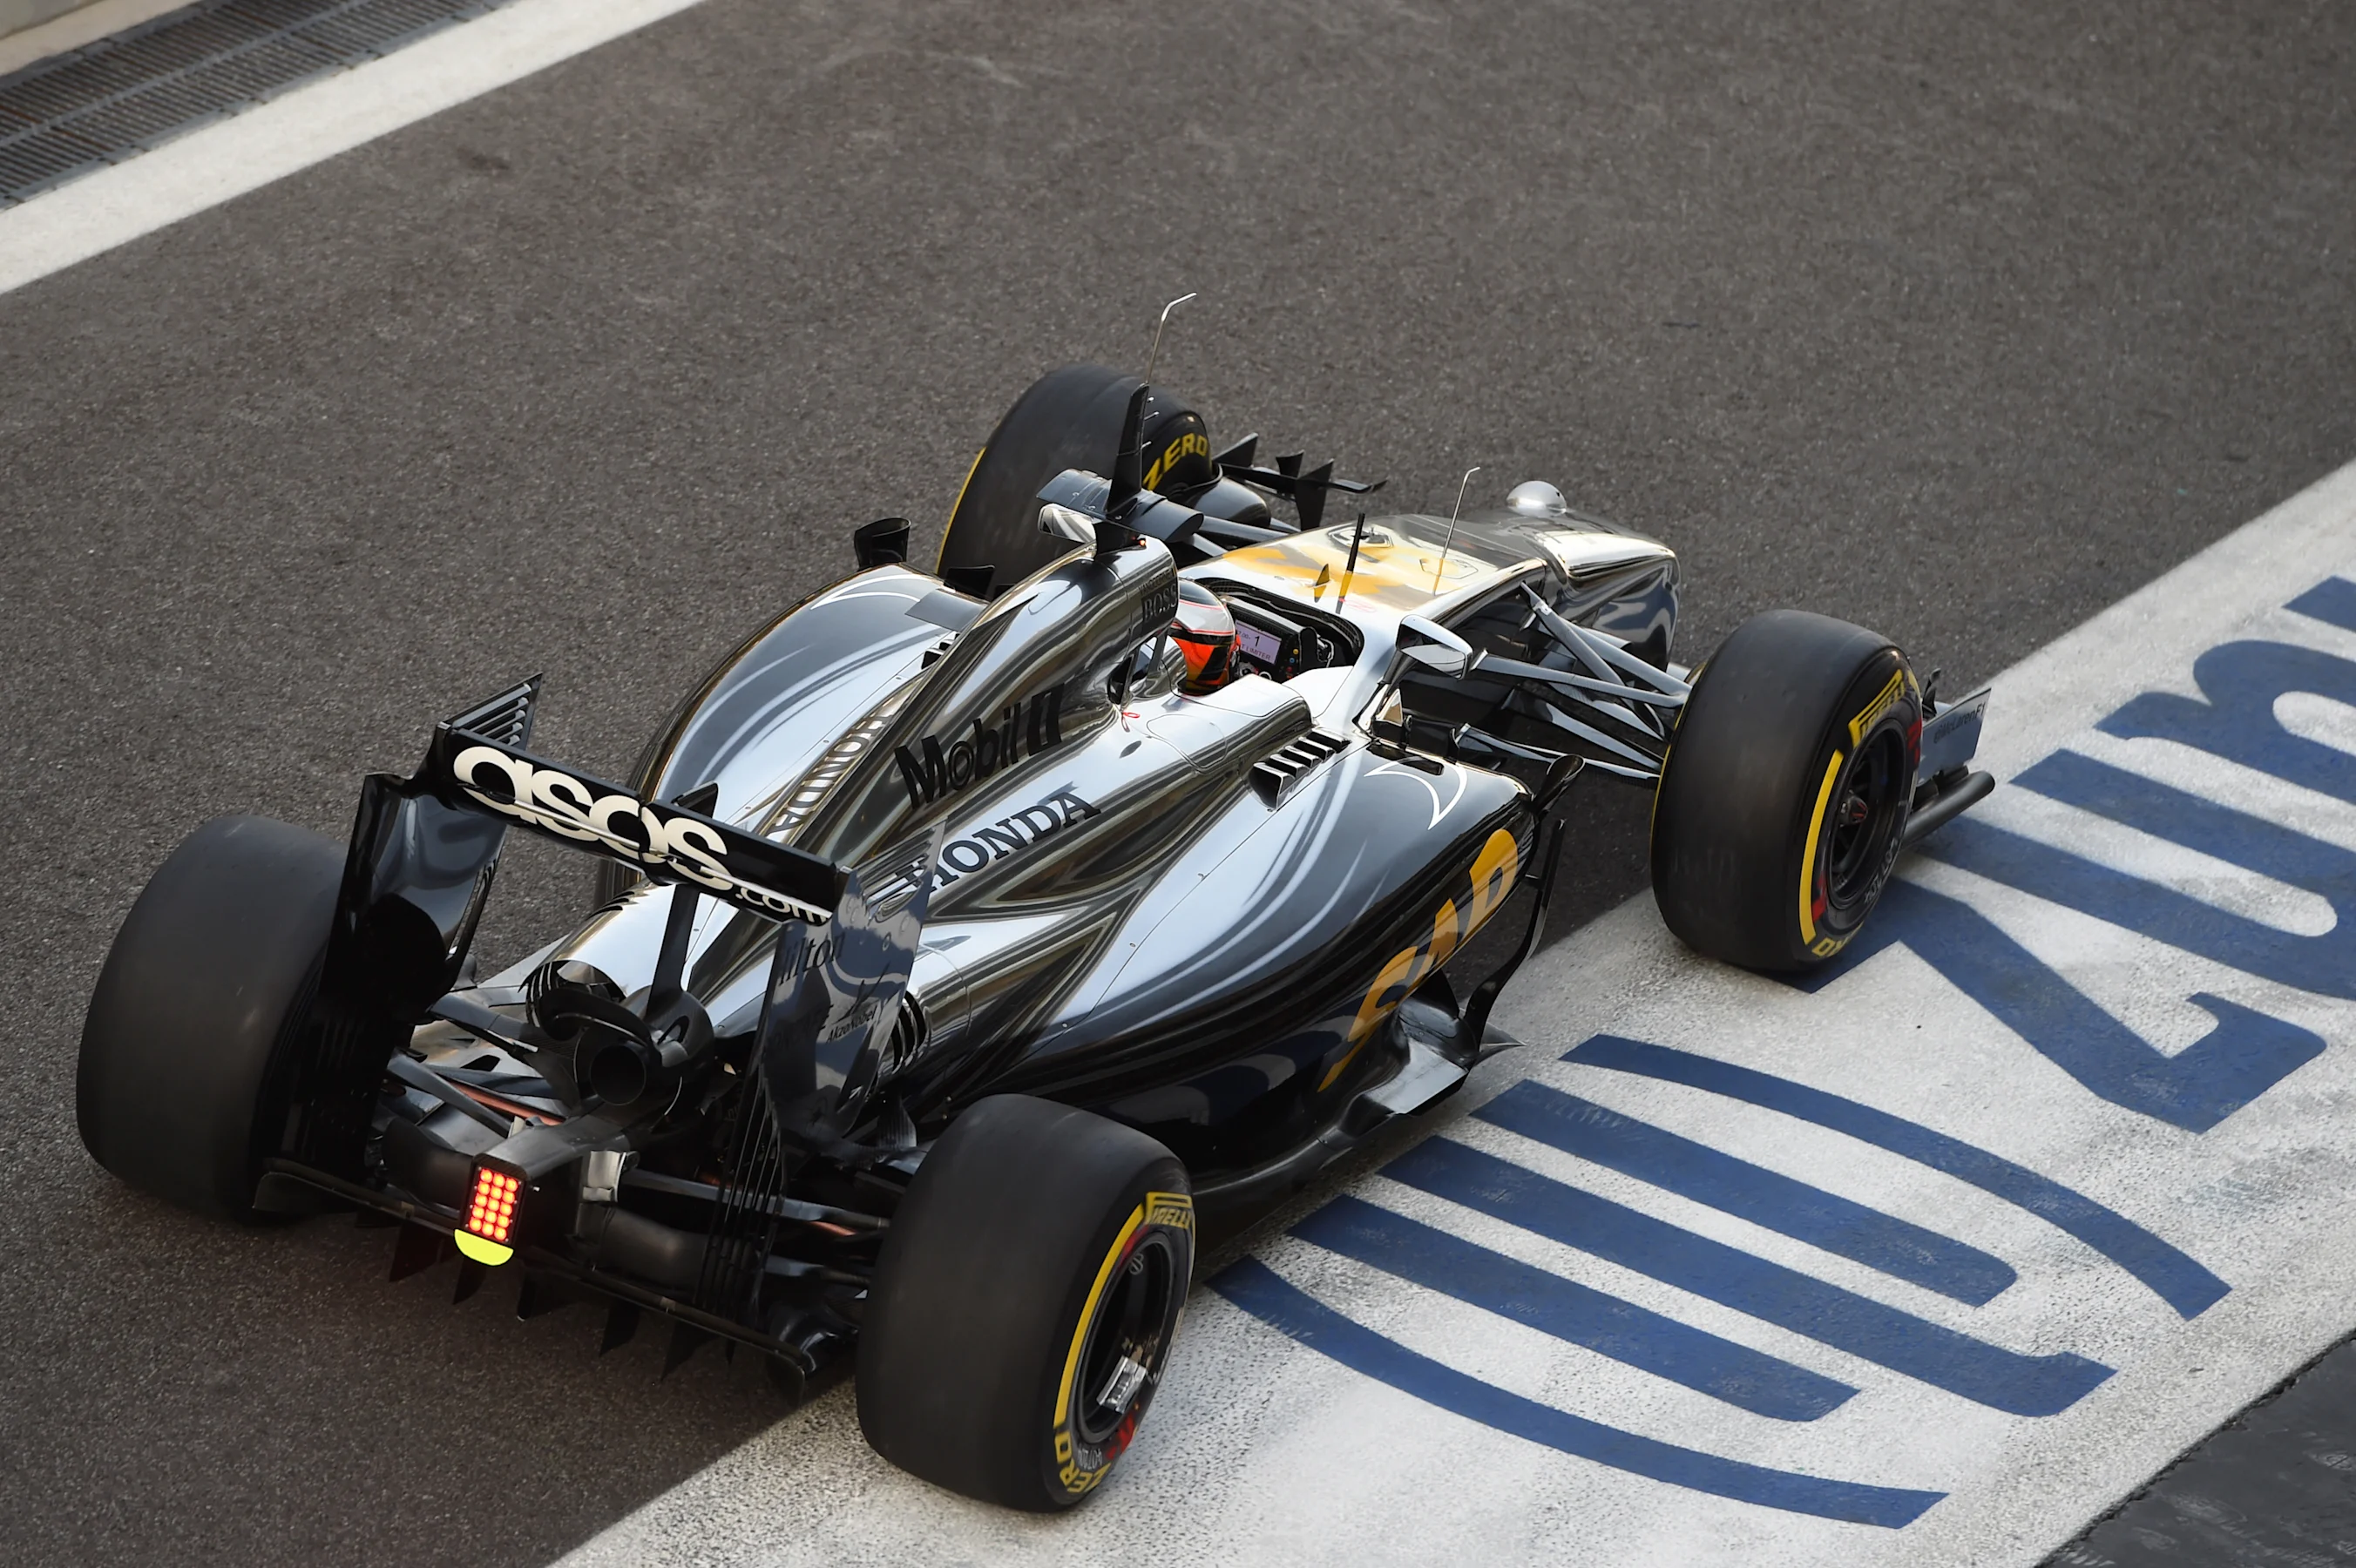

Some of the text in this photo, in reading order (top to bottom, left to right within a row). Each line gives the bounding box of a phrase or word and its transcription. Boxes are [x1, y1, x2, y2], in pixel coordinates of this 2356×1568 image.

[1141, 432, 1208, 492] ZERO
[1143, 582, 1178, 624] BOSS
[1246, 646, 1271, 661] LIMITER
[1254, 635, 1261, 647] 1
[1847, 668, 1906, 750] PIRELLI
[765, 714, 894, 837] HONDA
[894, 702, 1021, 809] Mobil
[826, 1004, 878, 1044] AkzoNobel
[1145, 1191, 1194, 1230] PIRELLI
[1053, 1429, 1112, 1494] ZERO
